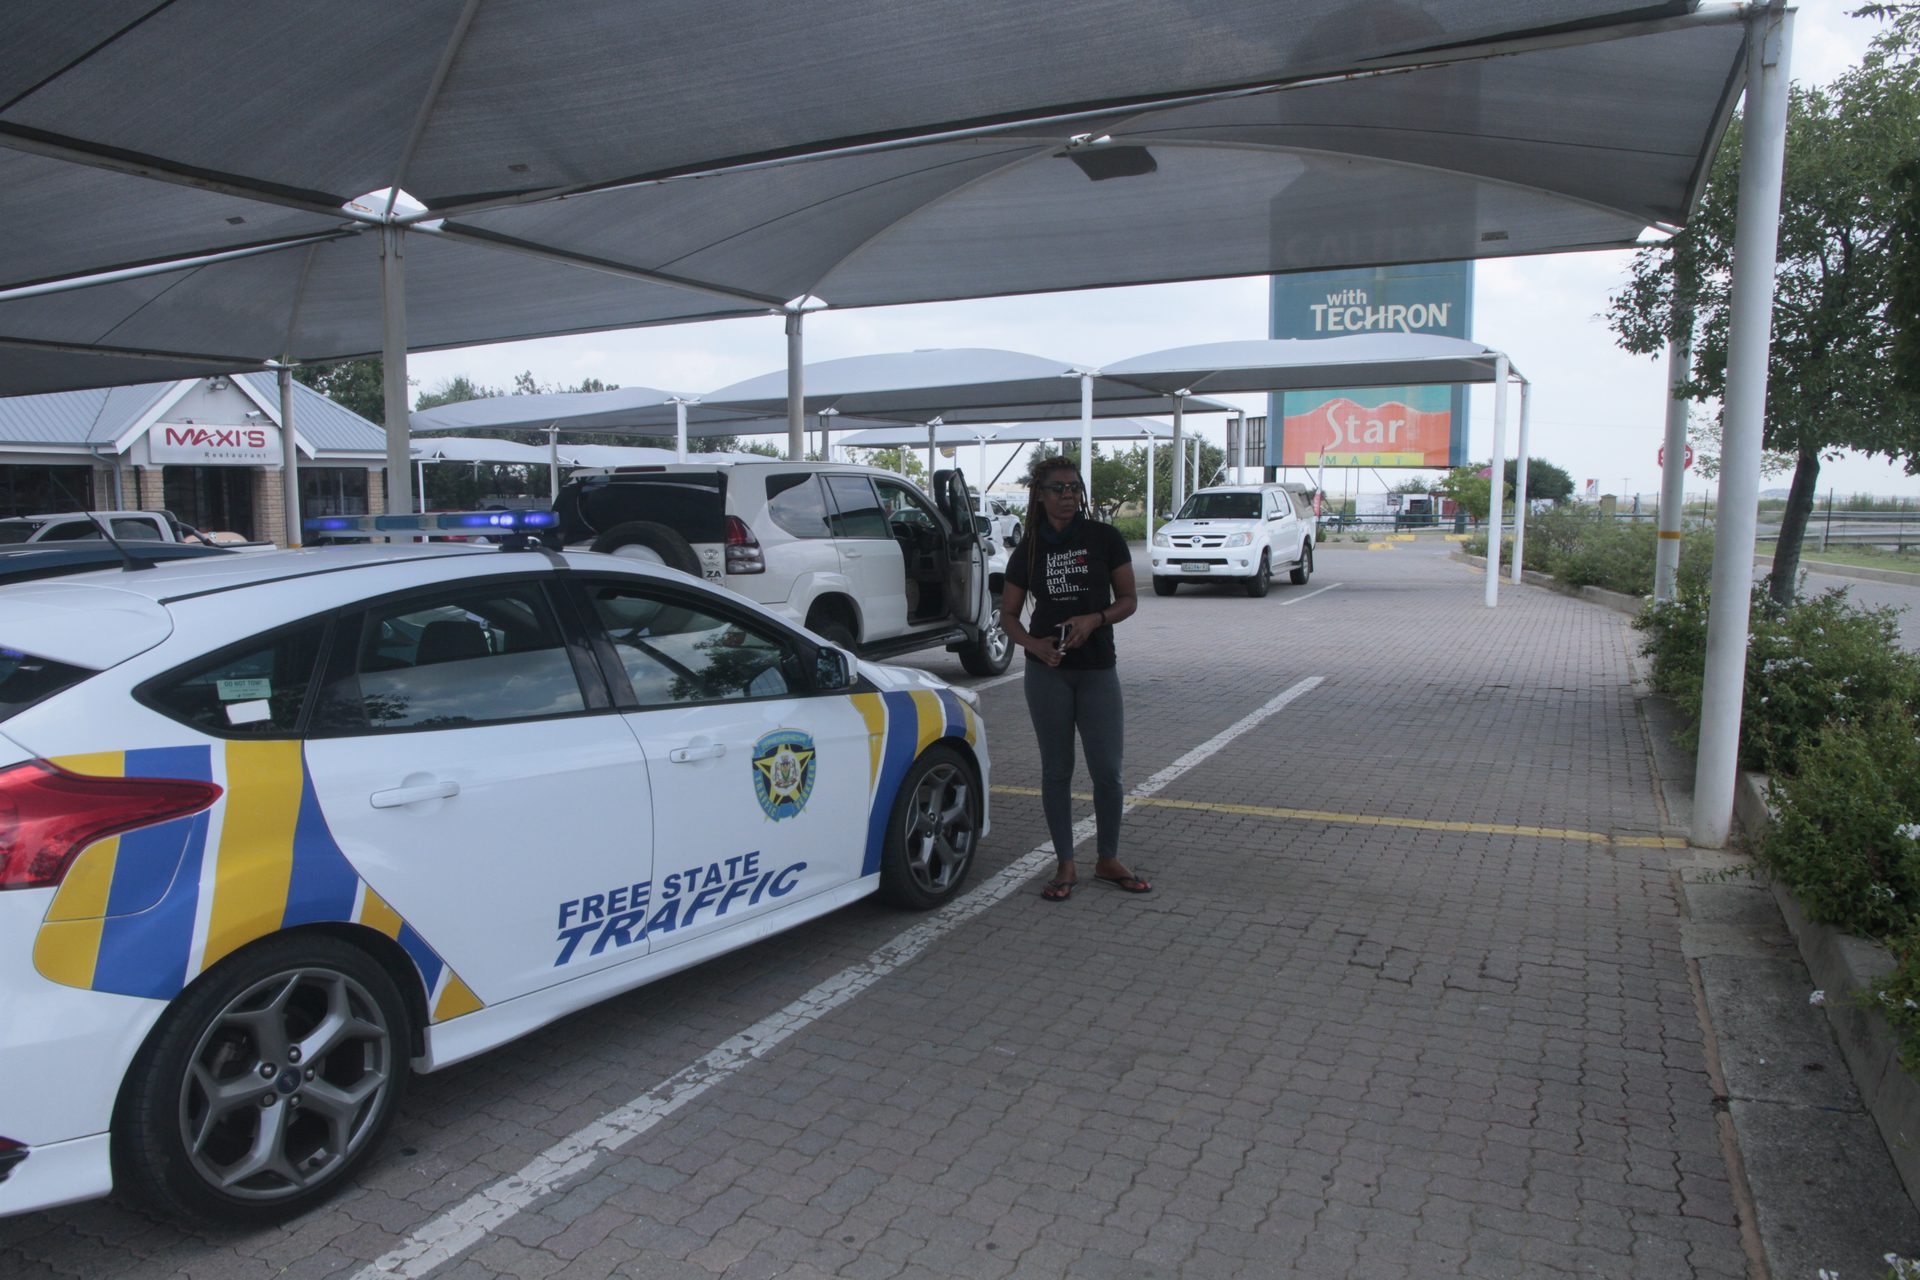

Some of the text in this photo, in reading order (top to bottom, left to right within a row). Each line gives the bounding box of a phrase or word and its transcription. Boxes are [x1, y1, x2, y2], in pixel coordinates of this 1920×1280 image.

[1326, 289, 1367, 306] with
[1310, 303, 1448, 333] TECHRON
[1324, 402, 1405, 450] Star
[165, 427, 265, 448] MAXI'S
[204, 451, 266, 459] Restaurant
[1325, 455, 1405, 466] MART
[1047, 549, 1088, 561] Lipgloss
[706, 570, 722, 578] ZA
[1046, 564, 1088, 577] Rocking
[1046, 574, 1067, 586] and
[558, 850, 760, 930] FREE STATE
[554, 861, 808, 968] TRAFFIC
